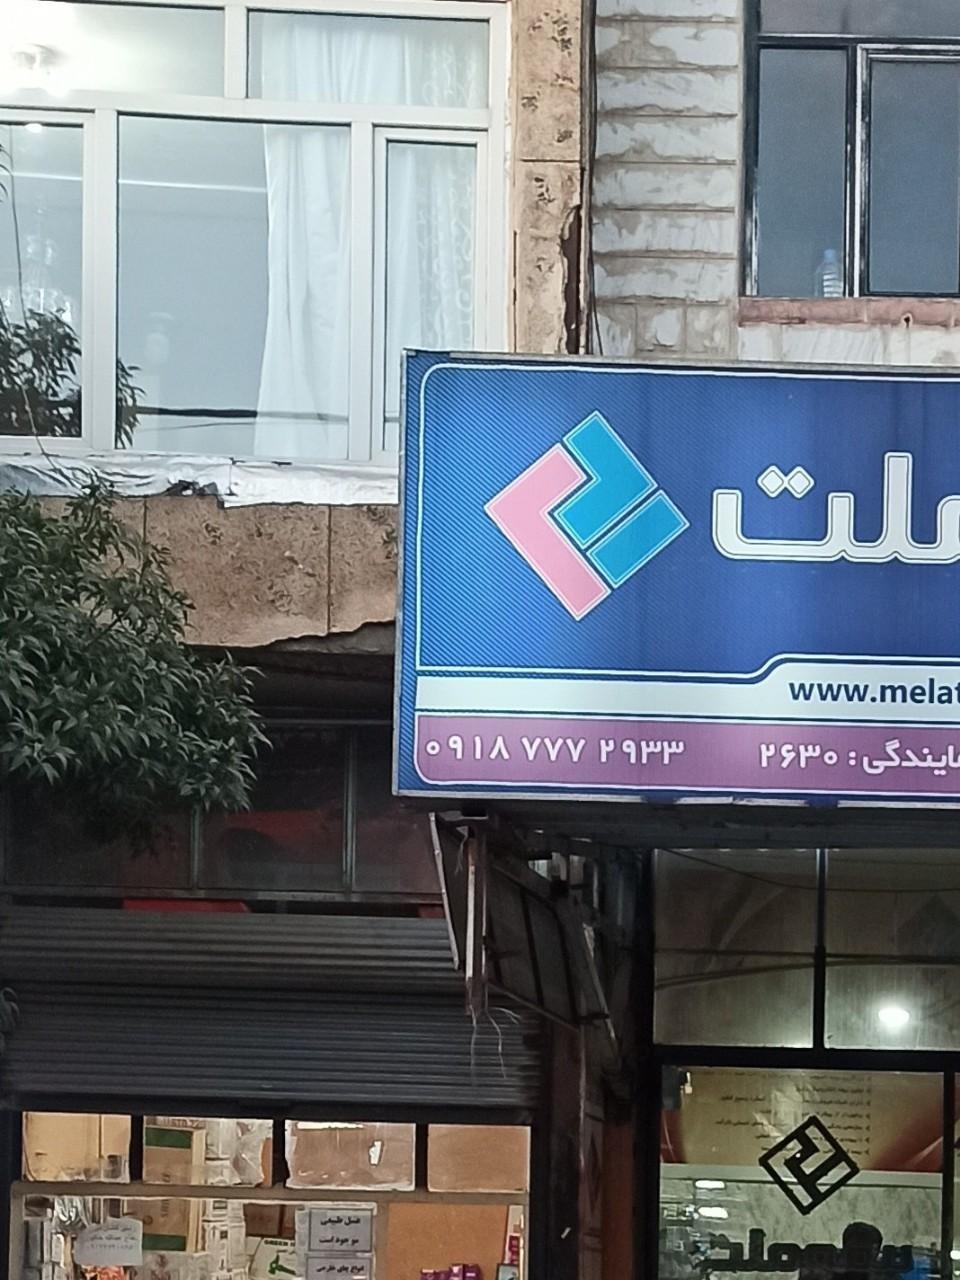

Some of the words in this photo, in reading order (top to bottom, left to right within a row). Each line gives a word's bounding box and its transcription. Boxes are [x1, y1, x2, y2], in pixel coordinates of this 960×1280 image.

[426, 735, 510, 760] ۰۹۱۸
[521, 737, 586, 762] ۷۷۷
[600, 739, 684, 765] ۲۹۳۳
[760, 743, 838, 769] ۲۶۳۰
